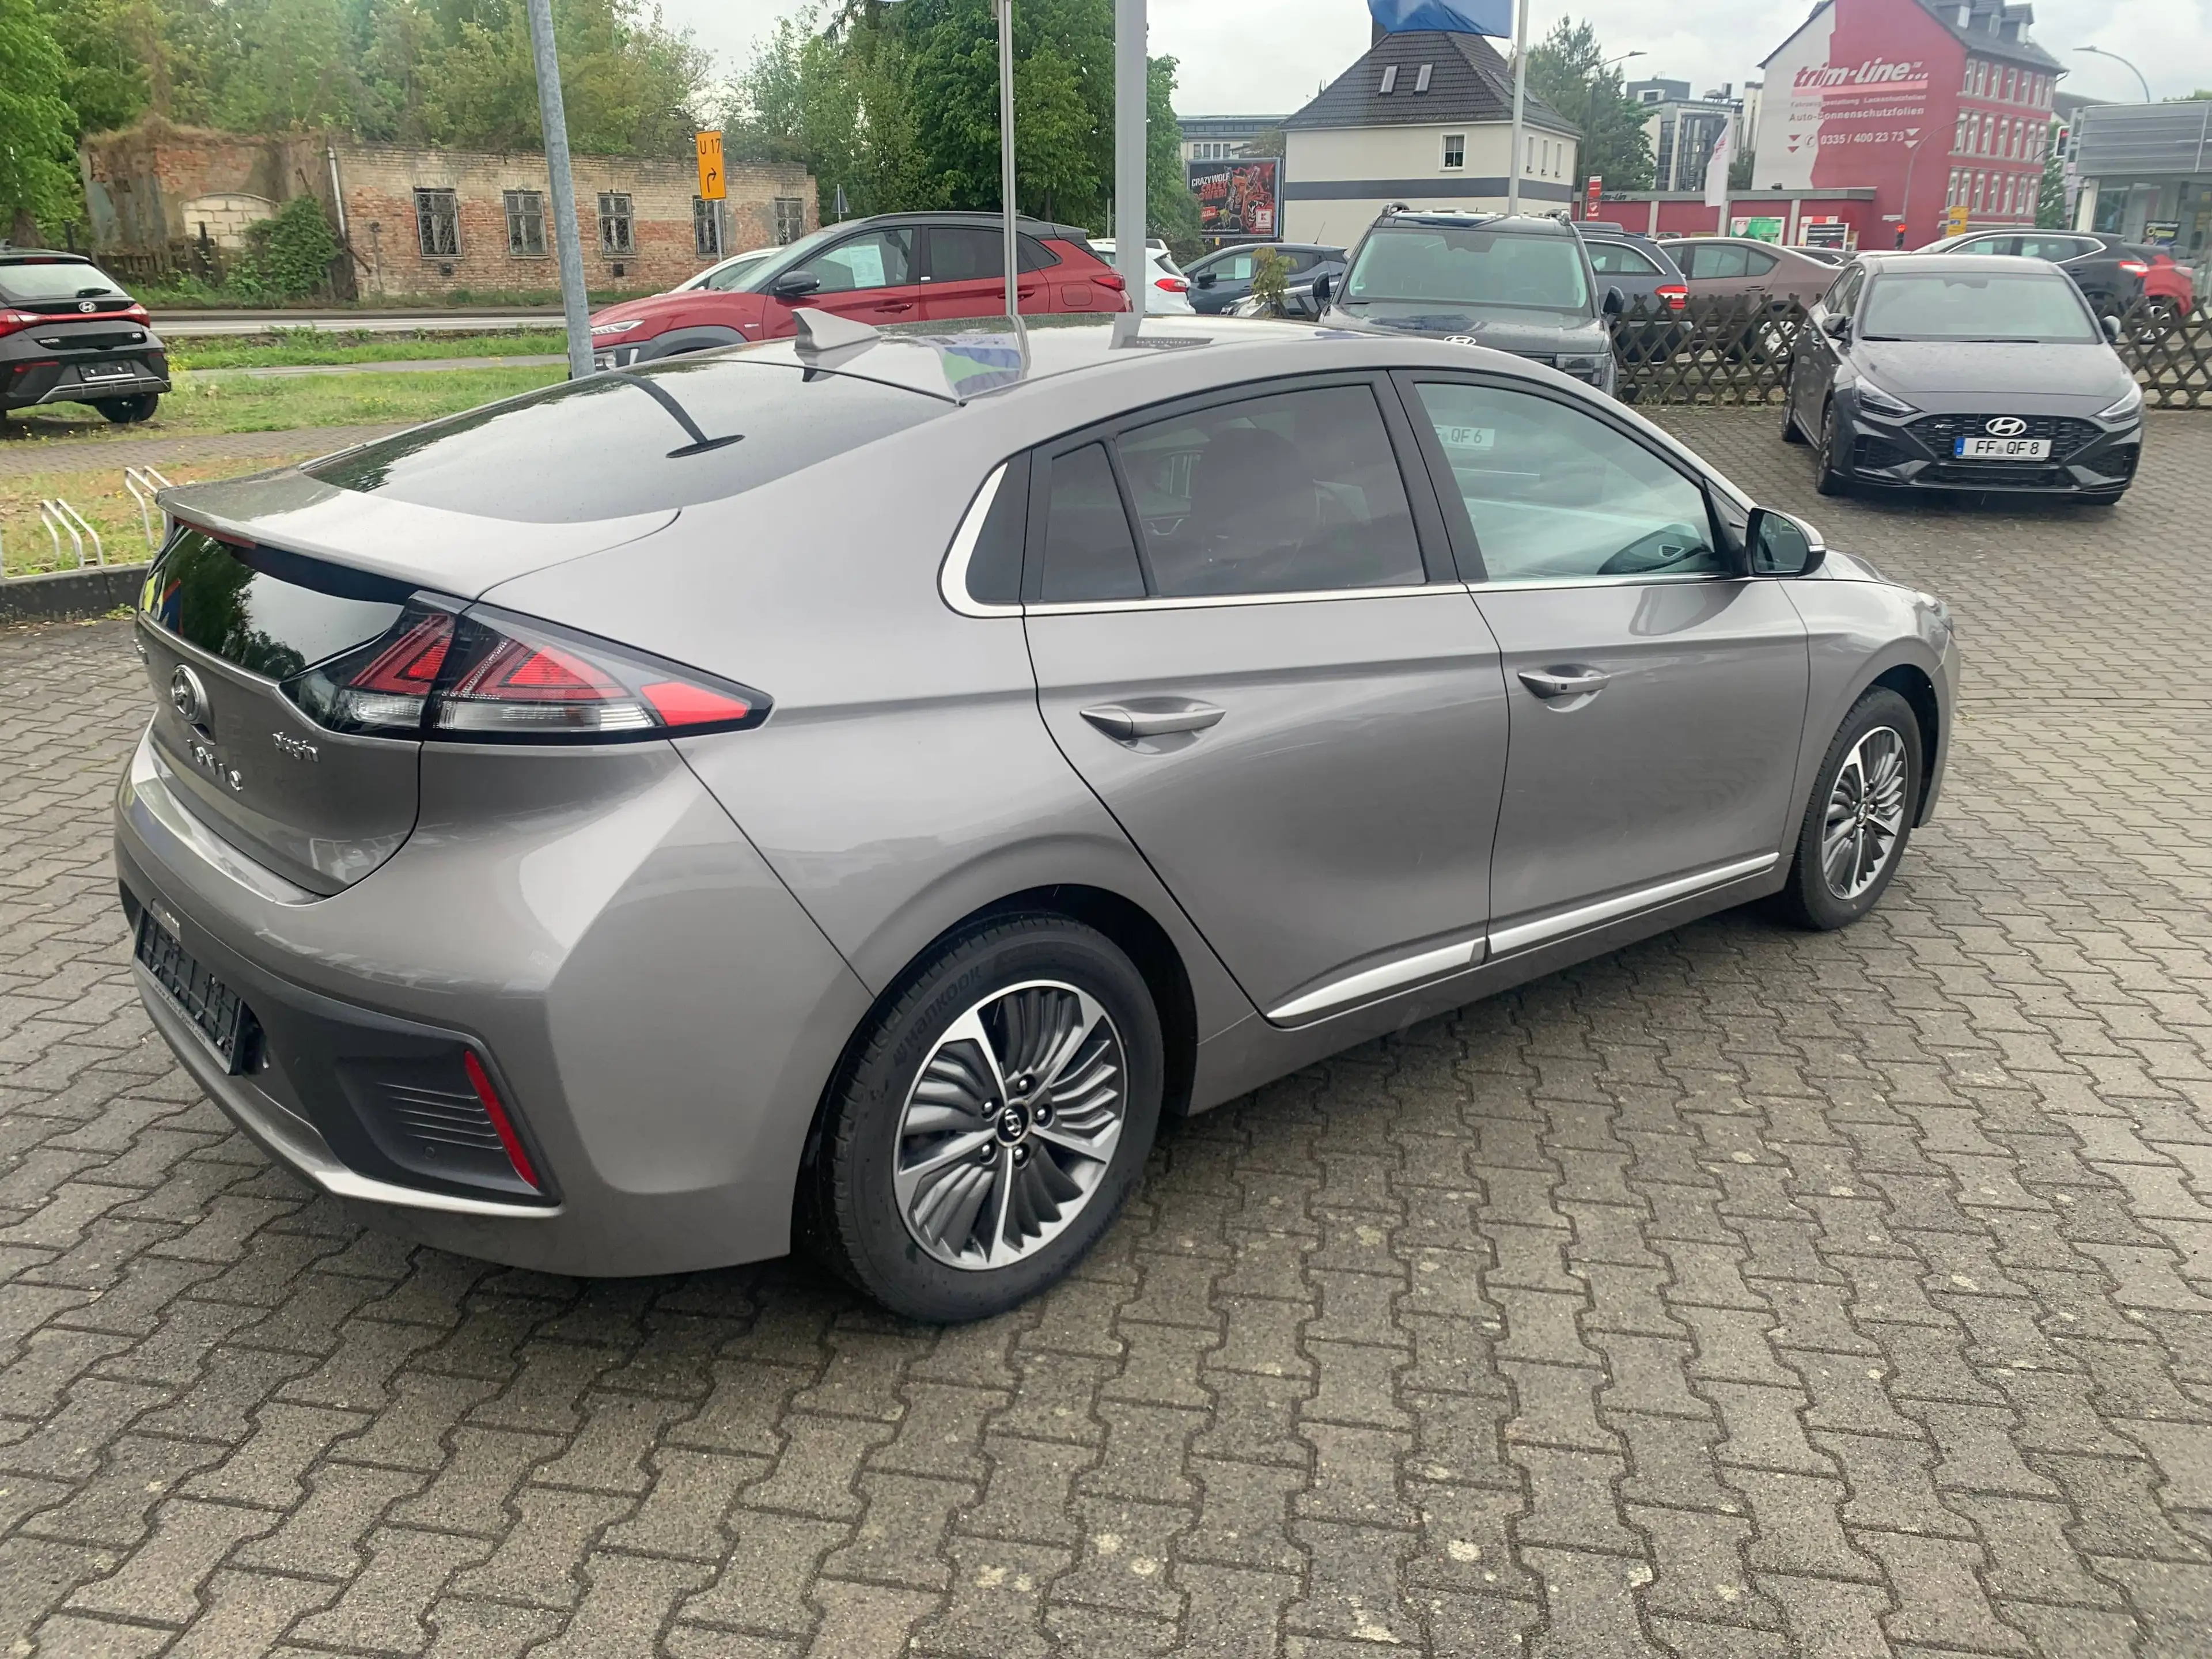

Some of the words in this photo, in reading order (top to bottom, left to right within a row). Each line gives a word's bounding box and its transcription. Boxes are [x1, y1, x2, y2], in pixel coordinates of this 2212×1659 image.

[1789, 107, 1925, 122] Auto-Sonnenschutzfolien
[1820, 134, 1846, 145] 0335
[1853, 132, 1873, 143] 400
[1874, 132, 1888, 143] 23
[1891, 131, 1905, 142] 73
[699, 140, 706, 155] U
[711, 138, 720, 154] 17
[1191, 175, 1211, 187] CRAZY
[1211, 172, 1230, 183] WOLF
[1200, 181, 1228, 193] CRAZY
[1451, 428, 1471, 443] QF
[1474, 429, 1483, 444] 6
[1975, 441, 1998, 454] FF
[2006, 441, 2028, 454] QF
[2029, 442, 2039, 455] 8
